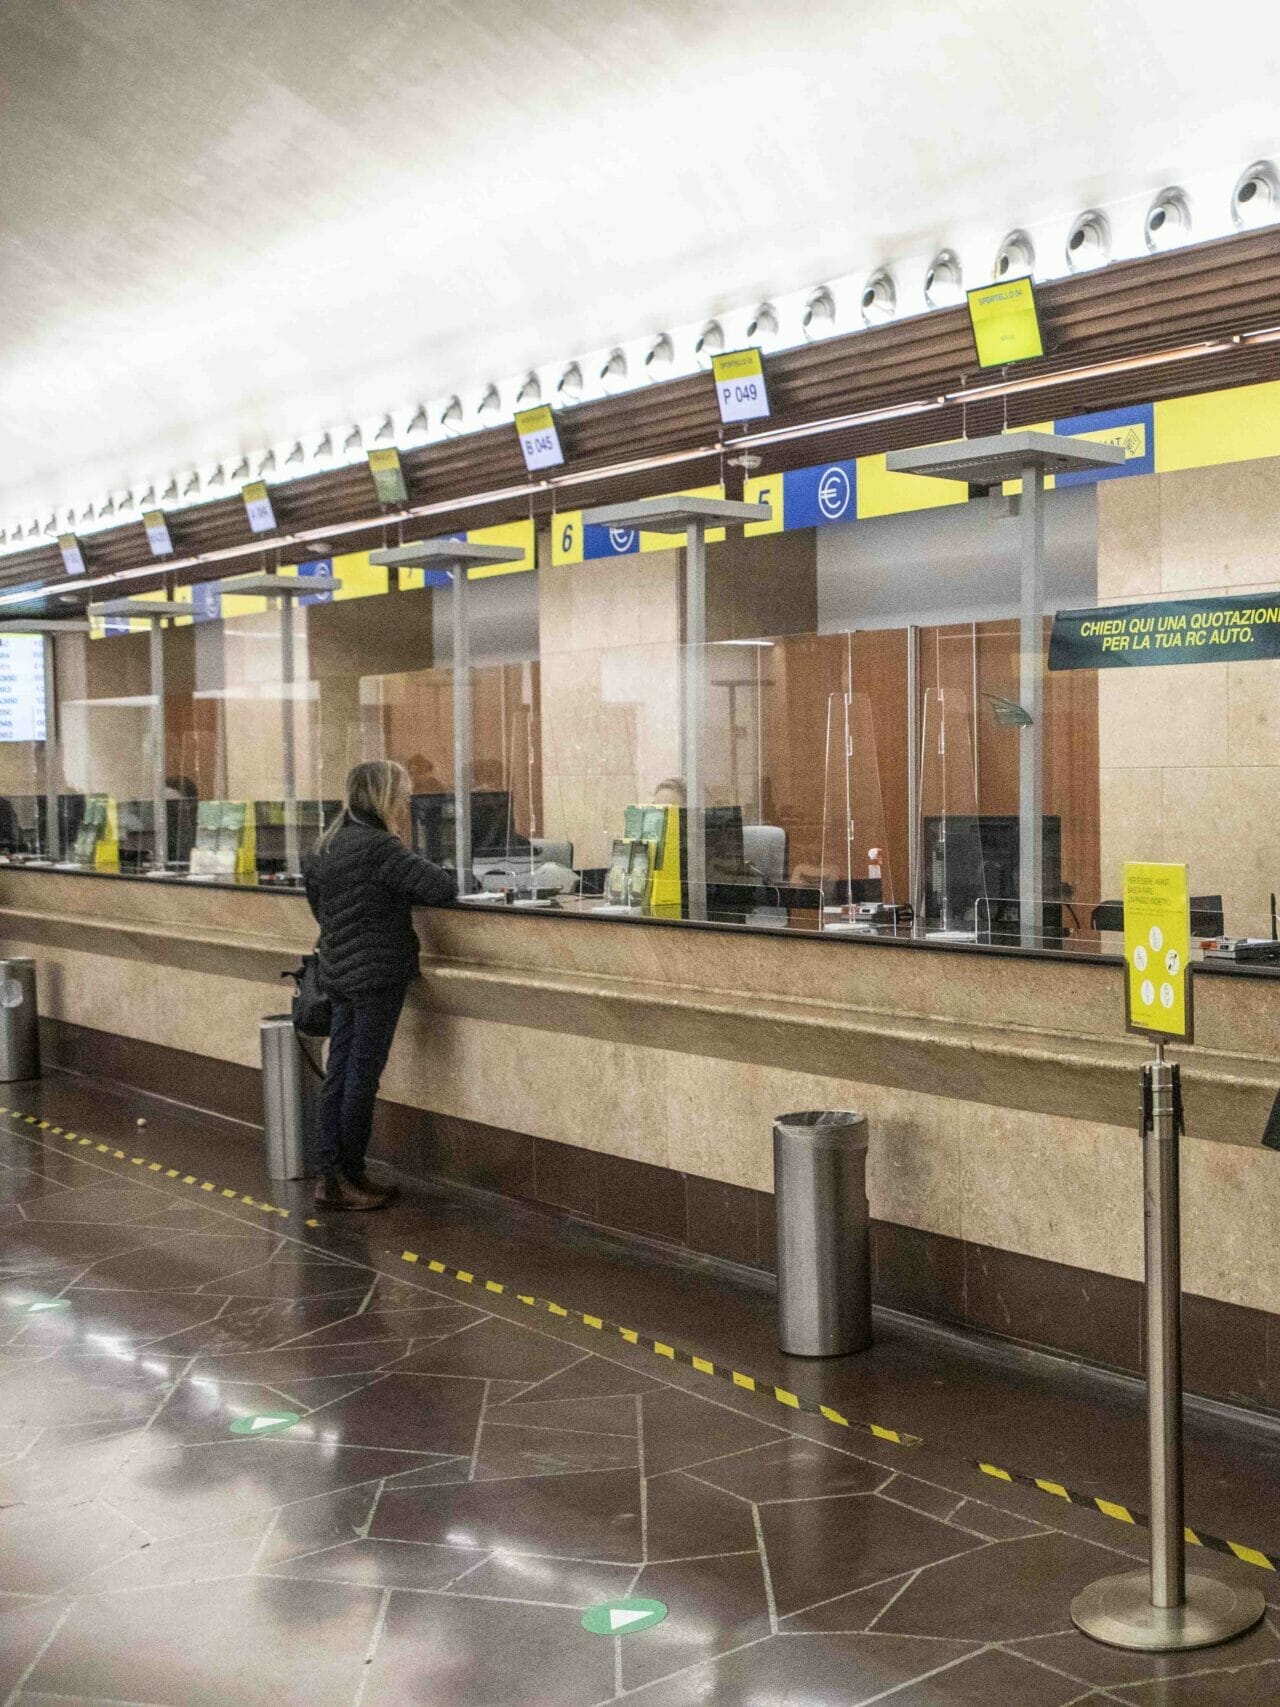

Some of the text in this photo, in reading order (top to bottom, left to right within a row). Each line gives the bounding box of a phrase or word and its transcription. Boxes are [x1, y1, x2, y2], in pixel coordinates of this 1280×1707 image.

[723, 383, 757, 404] P 049
[562, 524, 573, 553] 6
[1080, 620, 1126, 637] CHIEDI
[1129, 618, 1154, 632] QUI
[1158, 615, 1187, 632] UNA
[1102, 626, 1255, 652] PER LA TUA RC AUTO.
